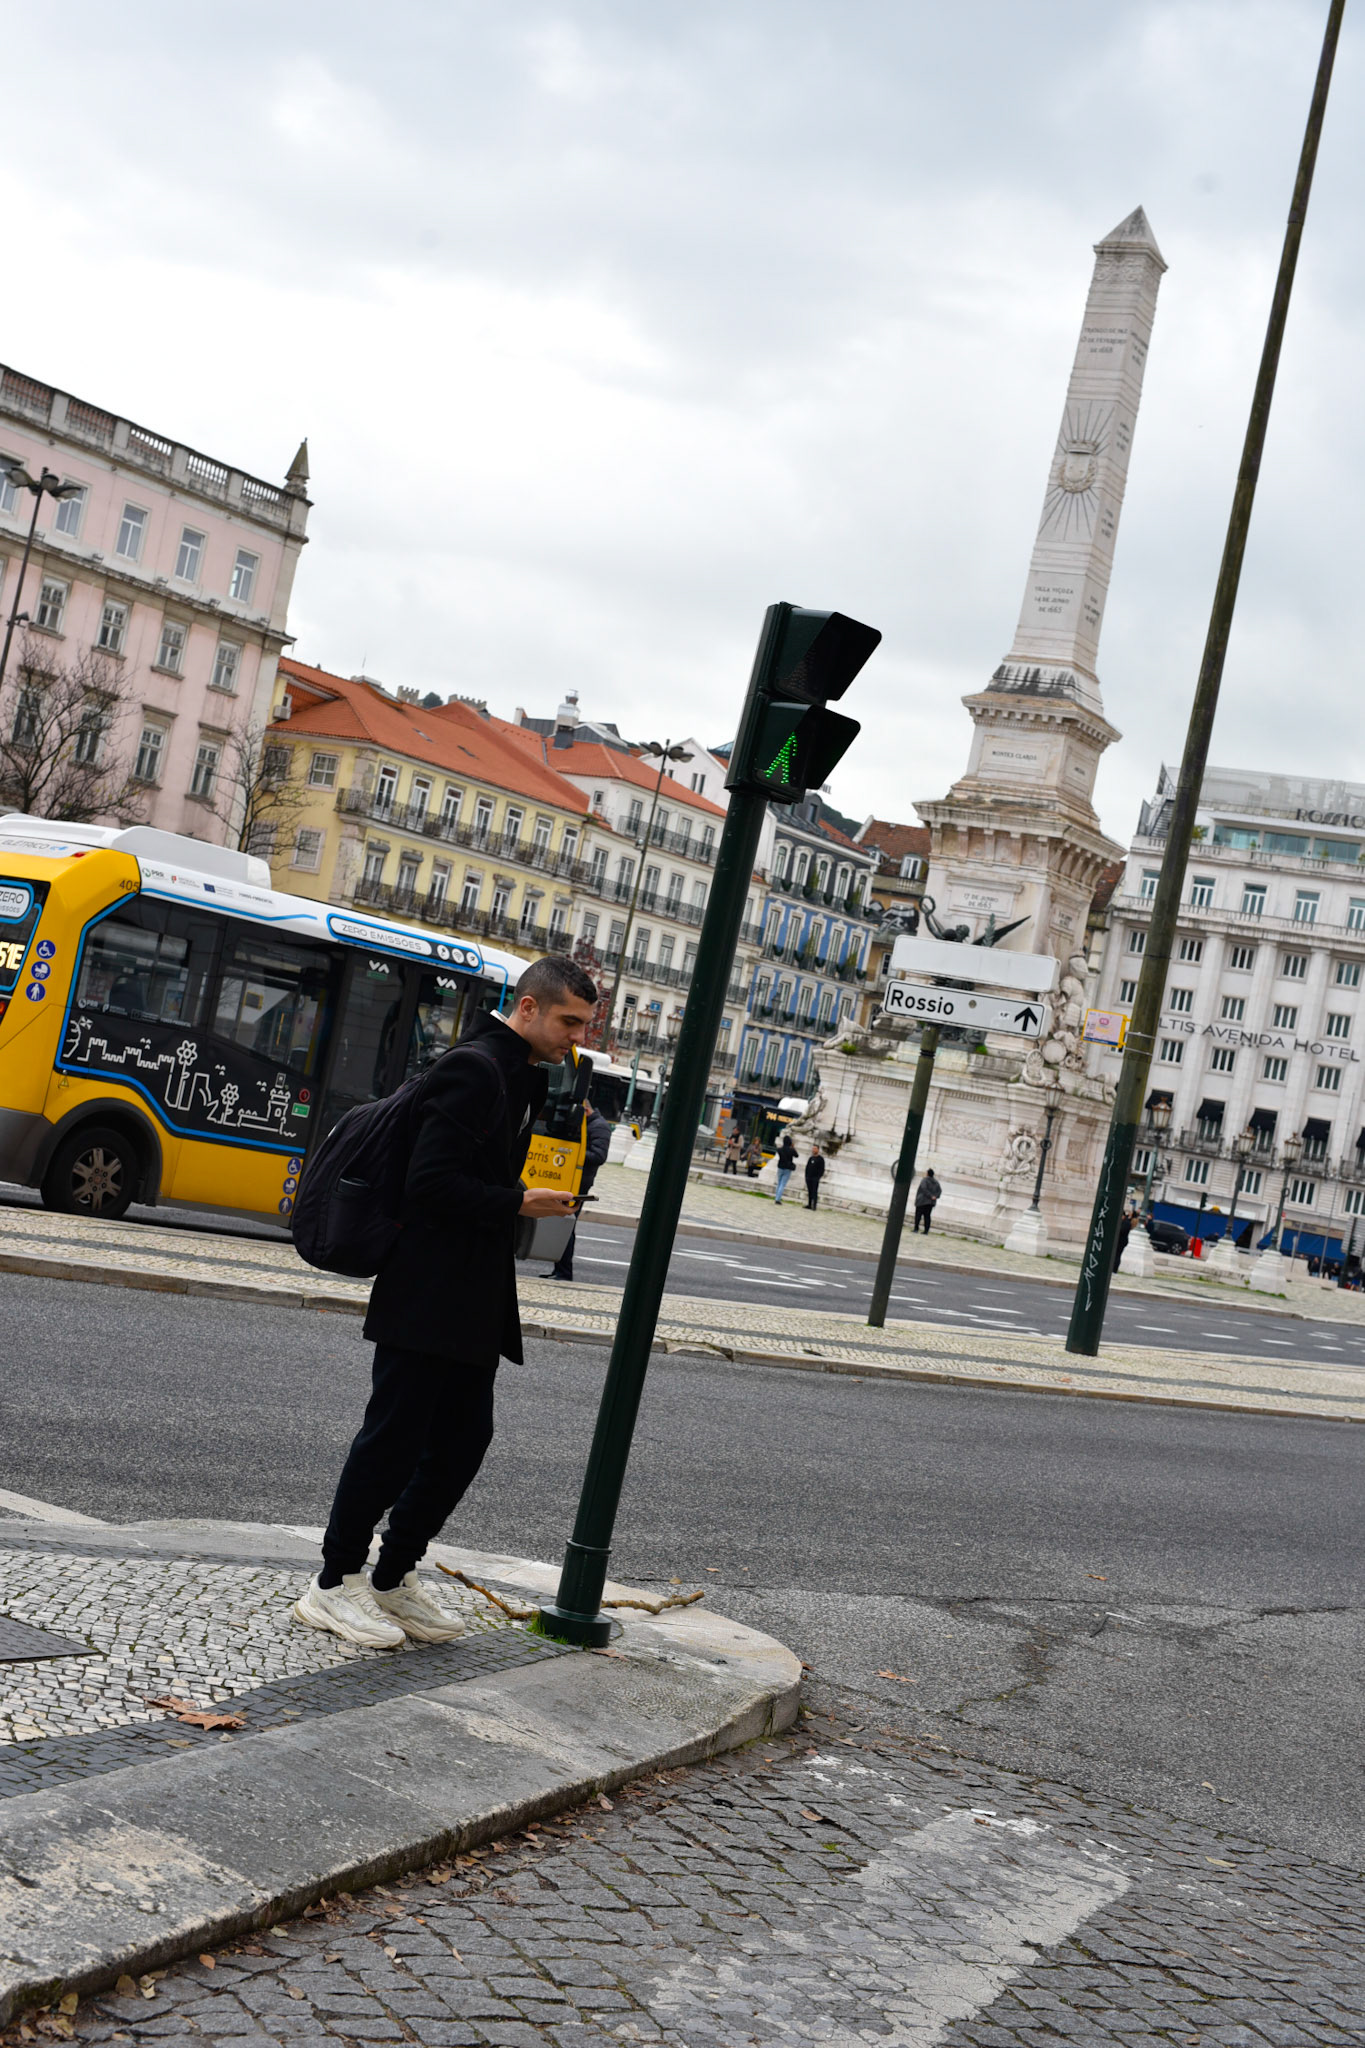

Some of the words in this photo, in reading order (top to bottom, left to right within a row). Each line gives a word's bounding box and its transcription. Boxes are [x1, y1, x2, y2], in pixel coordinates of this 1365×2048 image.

[992, 750, 1014, 759] MONTES
[1015, 753, 1037, 761] CLAROS
[971, 893, 980, 901] DE
[968, 900, 976, 908] DE
[341, 923, 368, 937] ZERO
[890, 989, 954, 1016] Rossio
[1158, 1017, 1196, 1034] LTIS
[1202, 1024, 1286, 1049] AVENIDA
[1293, 1038, 1361, 1063] HOTEL
[526, 1150, 549, 1164] arris
[537, 1168, 561, 1181] LISBOA
